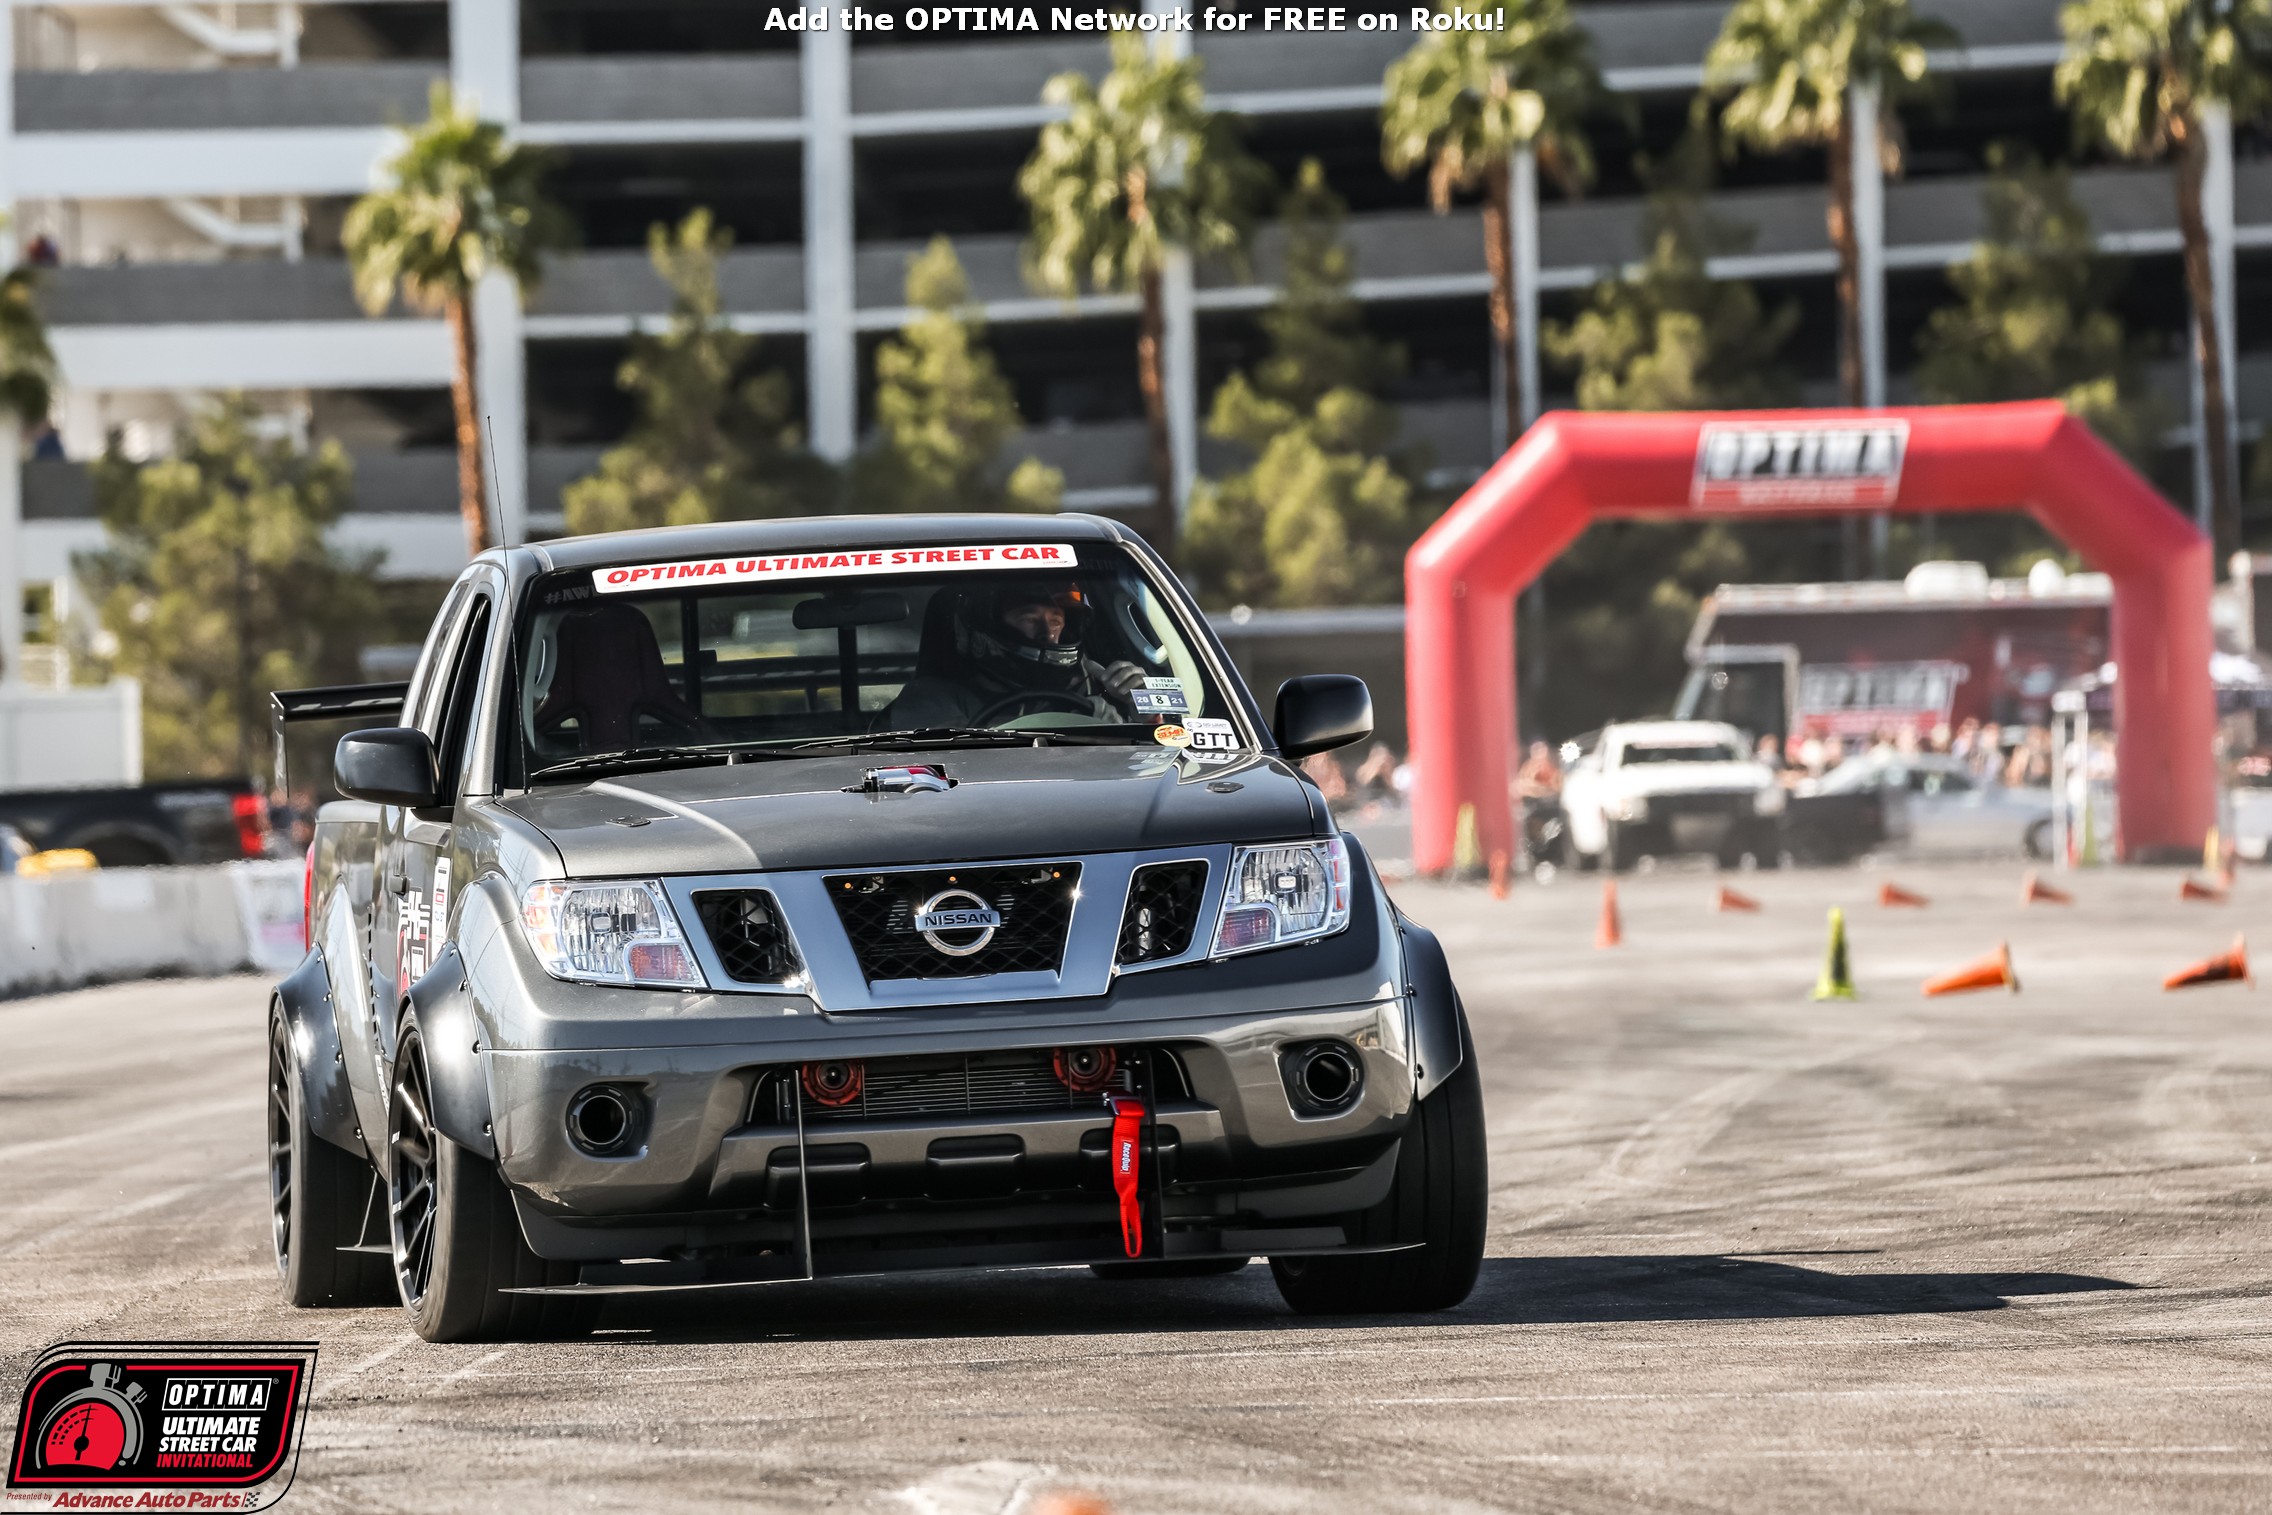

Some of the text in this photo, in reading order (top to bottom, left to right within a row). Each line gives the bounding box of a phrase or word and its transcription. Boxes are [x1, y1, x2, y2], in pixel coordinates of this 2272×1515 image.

[1705, 430, 1897, 479] OPTIMA
[607, 547, 1061, 584] OPTIMA ULTIMATE STREET CAR
[1155, 695, 1164, 705] 8
[1193, 732, 1233, 747] GTT
[925, 913, 992, 926] NISSAN
